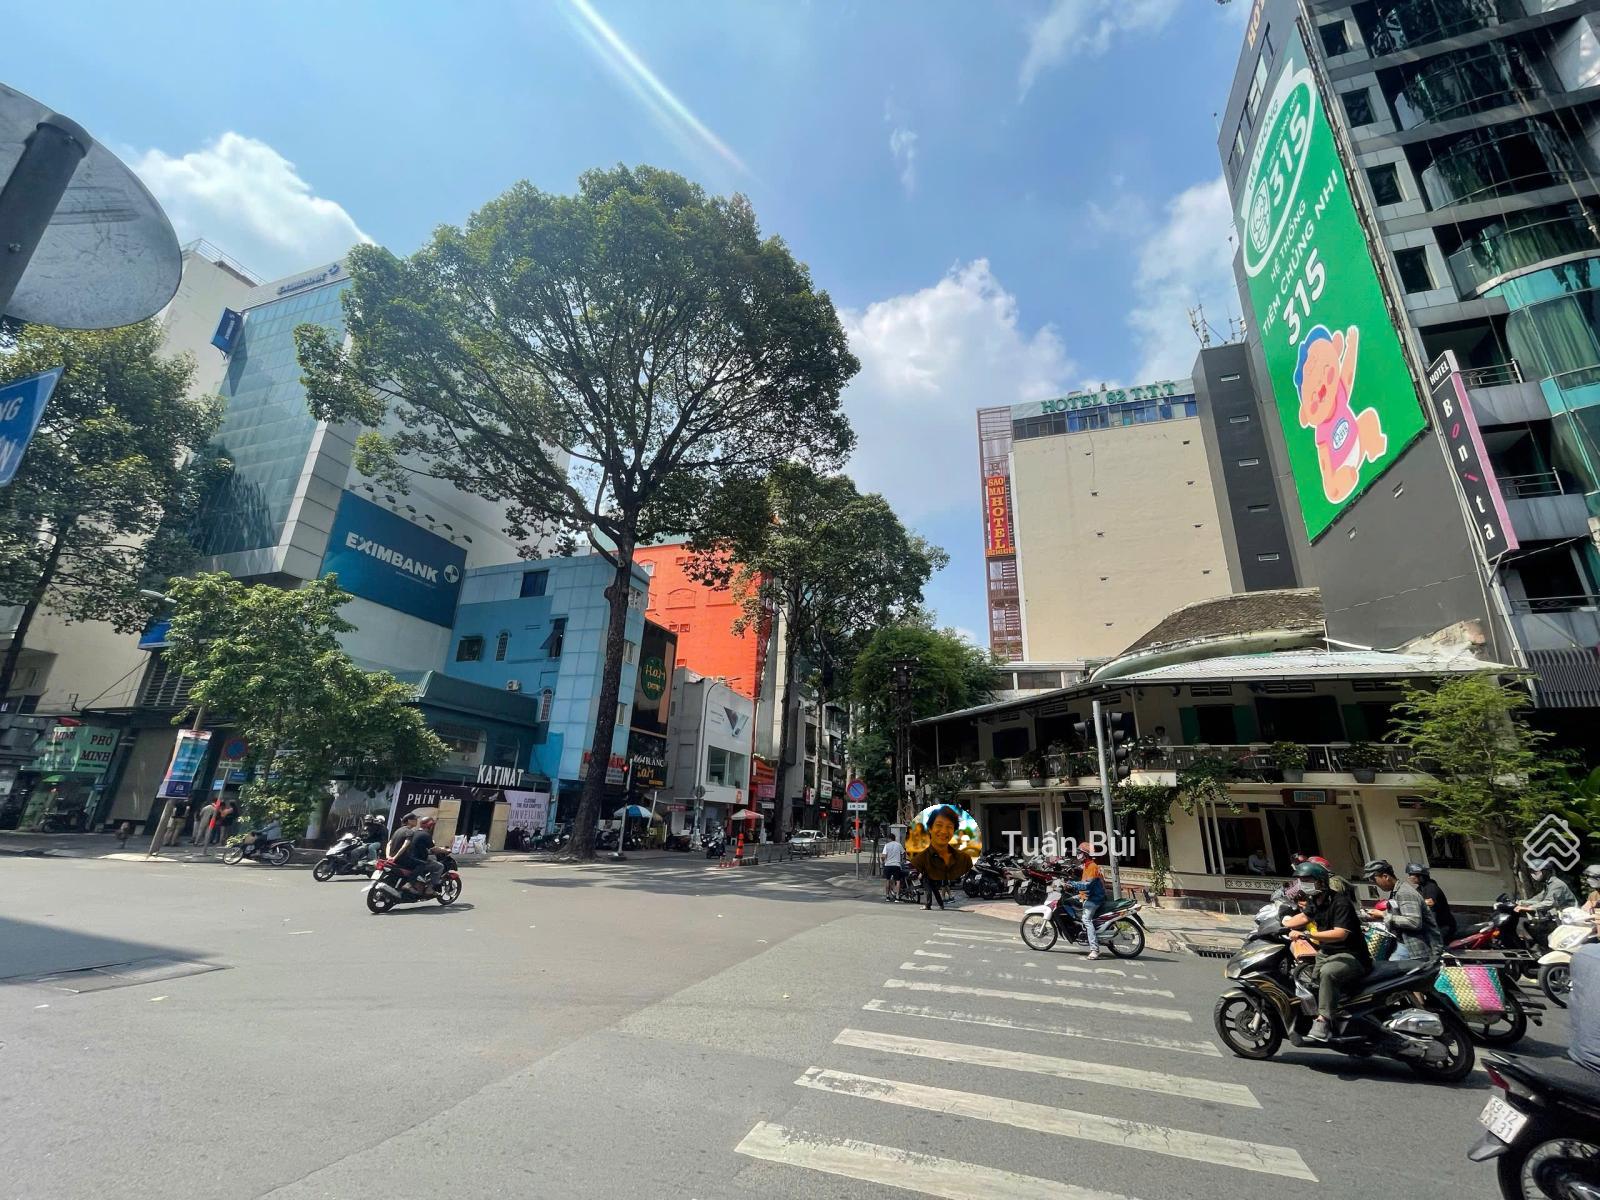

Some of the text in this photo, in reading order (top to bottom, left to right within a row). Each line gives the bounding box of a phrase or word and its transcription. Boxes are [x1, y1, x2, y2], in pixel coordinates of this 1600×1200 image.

[1270, 103, 1307, 207] 315
[1263, 169, 1339, 336] TIÊM CHỦNG NHI
[1271, 200, 1306, 283] HỆ THỐNG
[1283, 248, 1326, 346] 315
[1429, 361, 1450, 386] HOTEL
[1040, 394, 1102, 413] HOTEL
[1106, 390, 1127, 404] 82
[988, 478, 1004, 486] SAO
[989, 487, 1005, 496] MAI
[1442, 398, 1496, 541] Bonita
[991, 496, 1006, 549] HOTEL
[345, 531, 439, 583] EXIMBANK
[406, 793, 435, 806] PHIN
[477, 764, 525, 787] KATINAT
